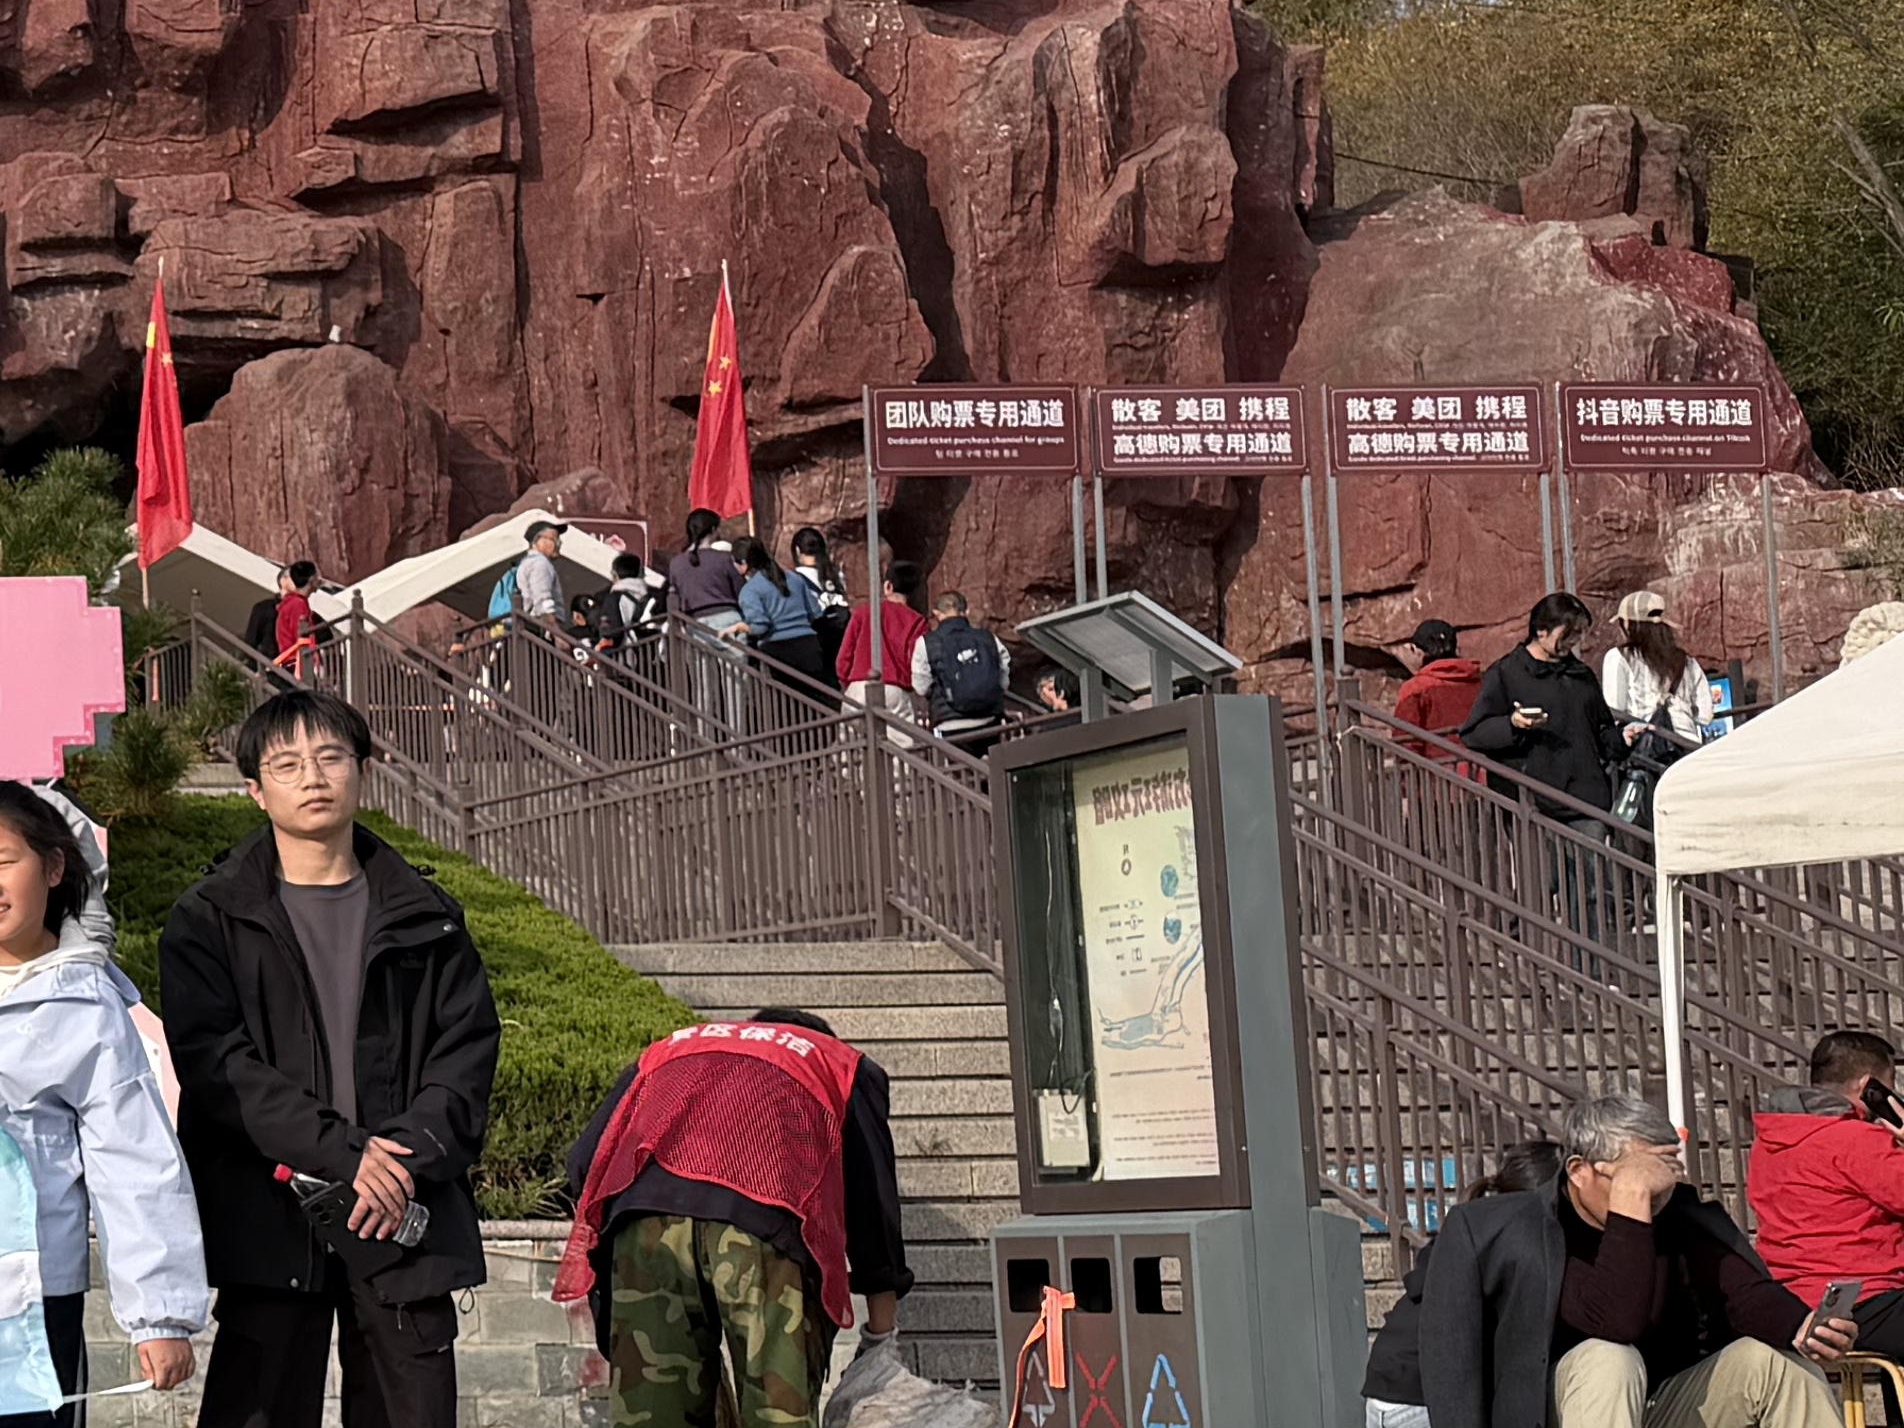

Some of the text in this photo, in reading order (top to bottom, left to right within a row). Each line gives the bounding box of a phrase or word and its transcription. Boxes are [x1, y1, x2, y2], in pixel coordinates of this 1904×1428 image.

[885, 400, 1065, 429] 团队购票专用通道
[1111, 397, 1291, 422] 散客 美团 携程
[1346, 395, 1528, 421] 散客 美团 携程
[1576, 398, 1753, 426] 抖音购票专用通道
[1113, 432, 1293, 455] 高德购票专用通道
[1348, 431, 1530, 454] 高德购票专用通道
